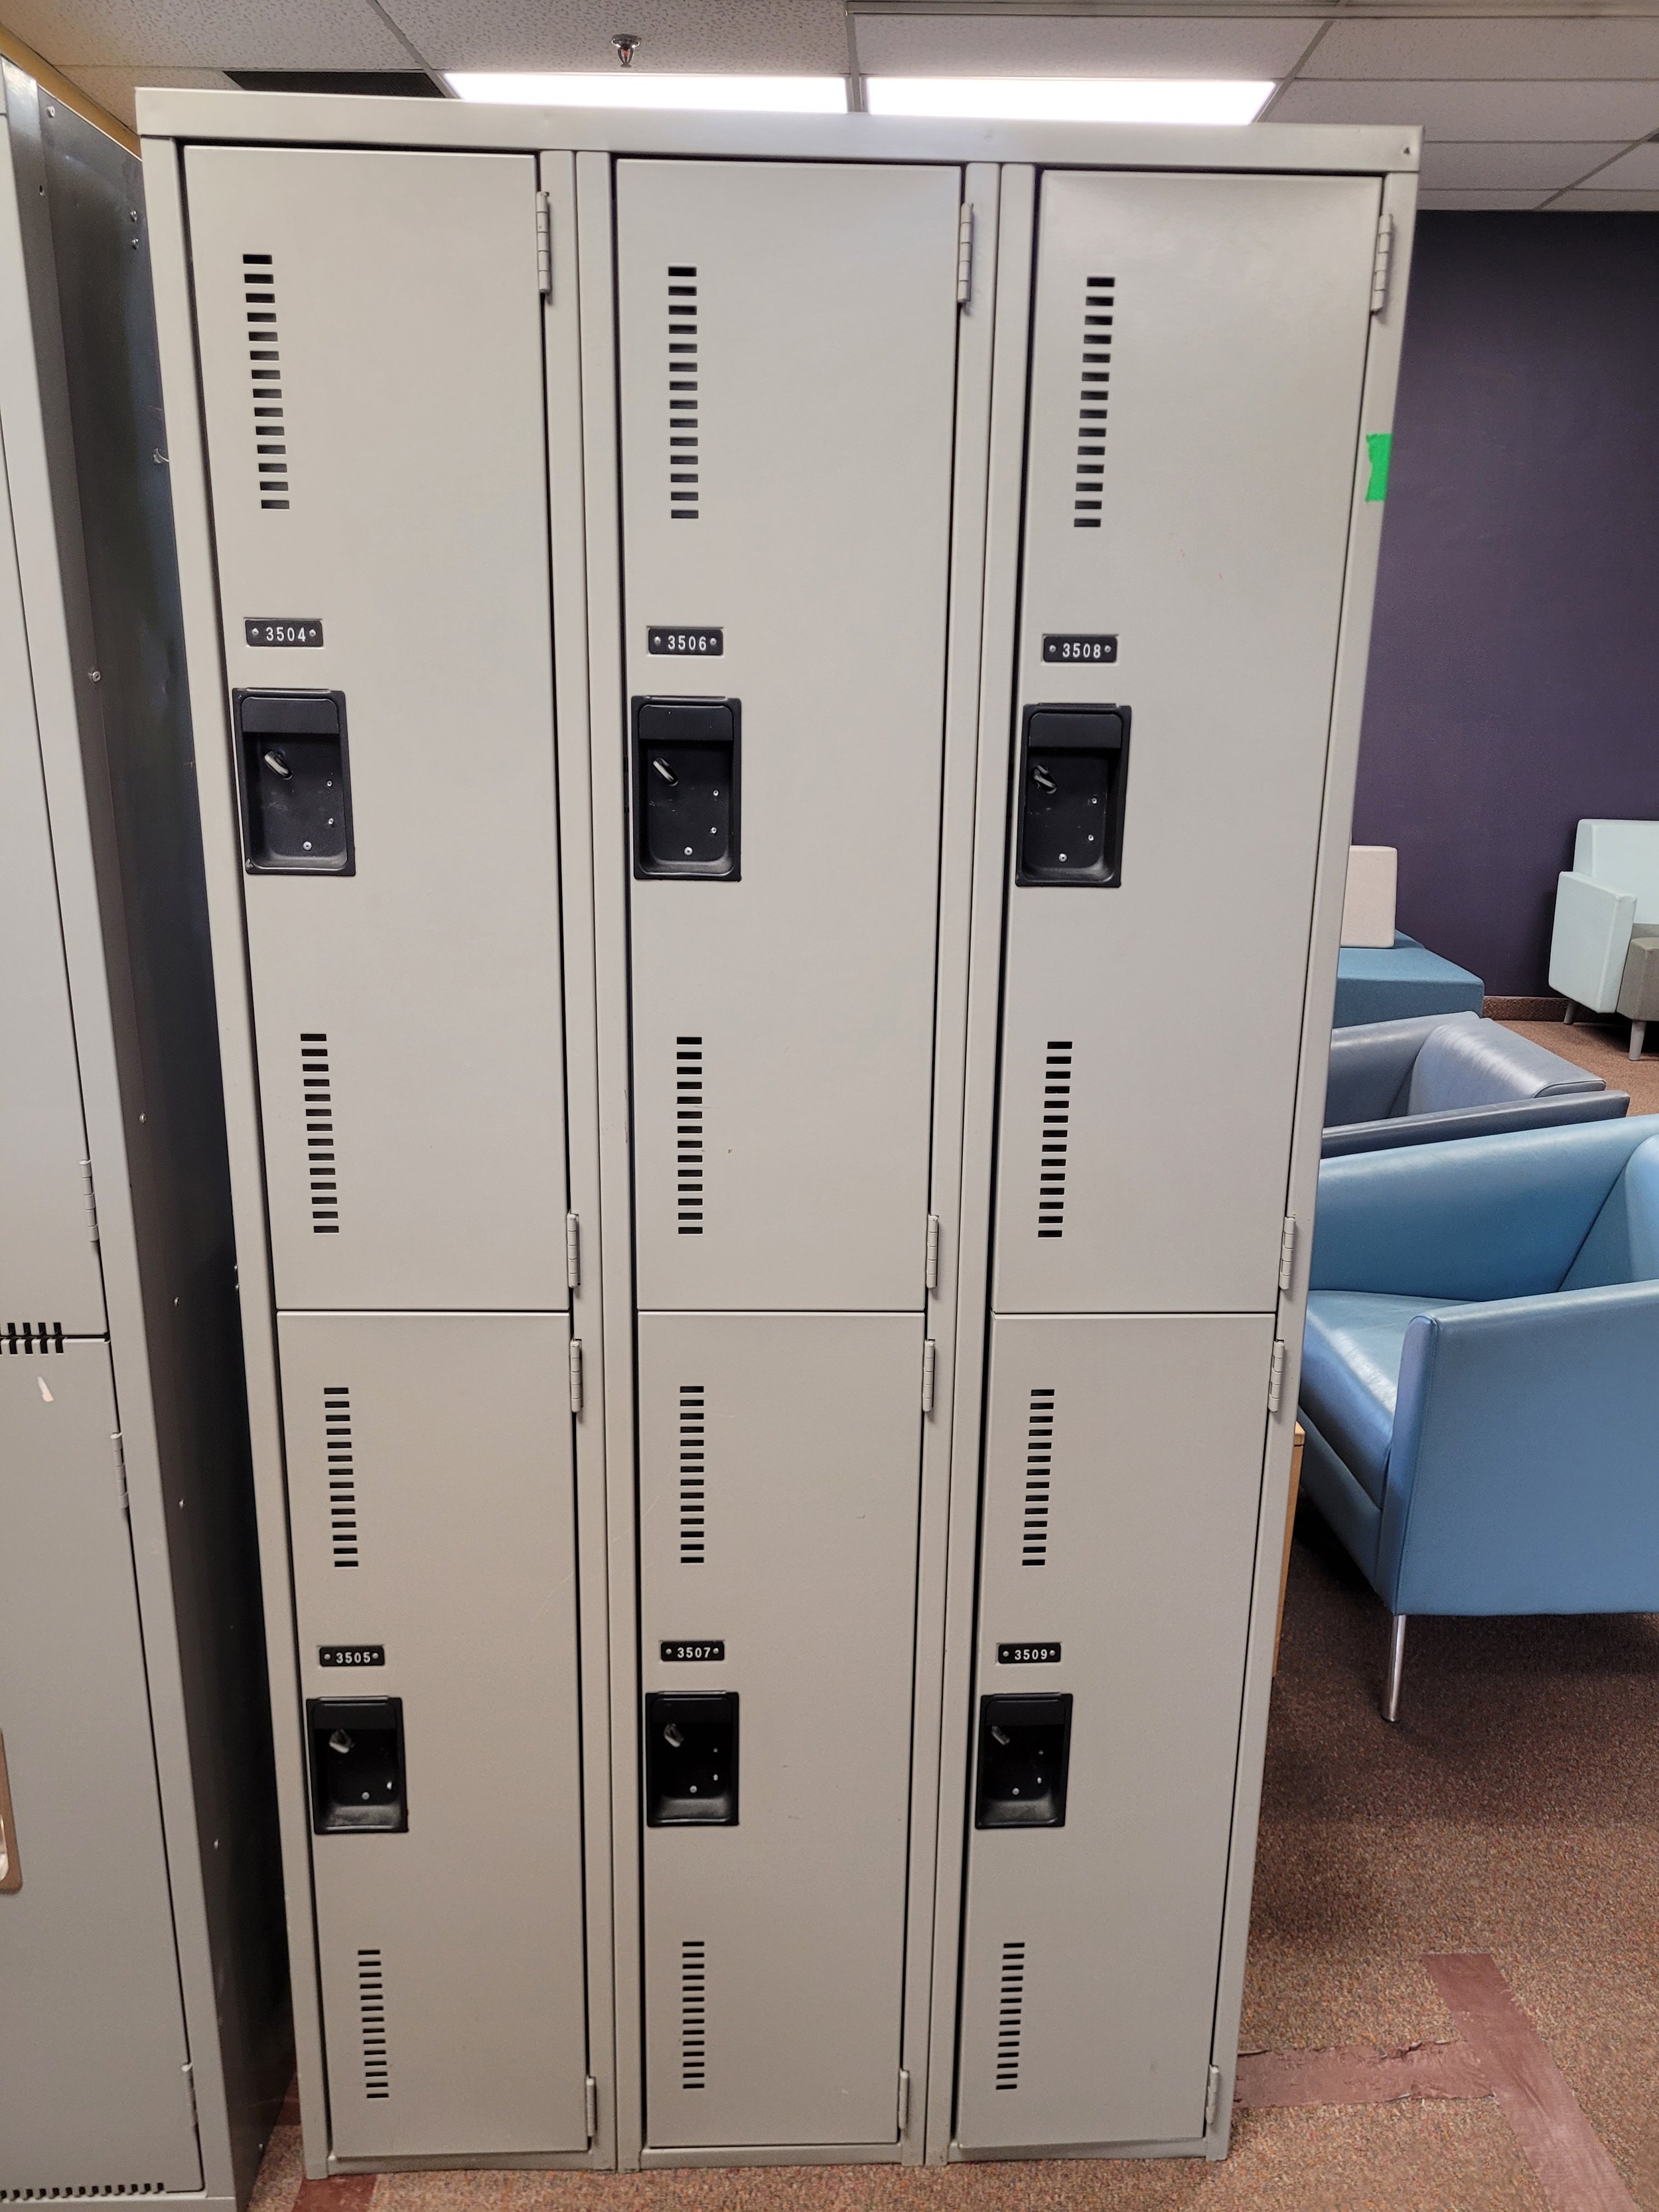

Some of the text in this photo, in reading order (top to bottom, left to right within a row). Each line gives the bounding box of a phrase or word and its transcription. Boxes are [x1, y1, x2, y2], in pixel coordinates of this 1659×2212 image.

[266, 627, 306, 642] 3504
[668, 635, 707, 650] 3506
[1062, 642, 1101, 658] 3508
[336, 1652, 371, 1664] 3505
[678, 1647, 711, 1659] 3507
[1014, 1649, 1048, 1660] 3509
